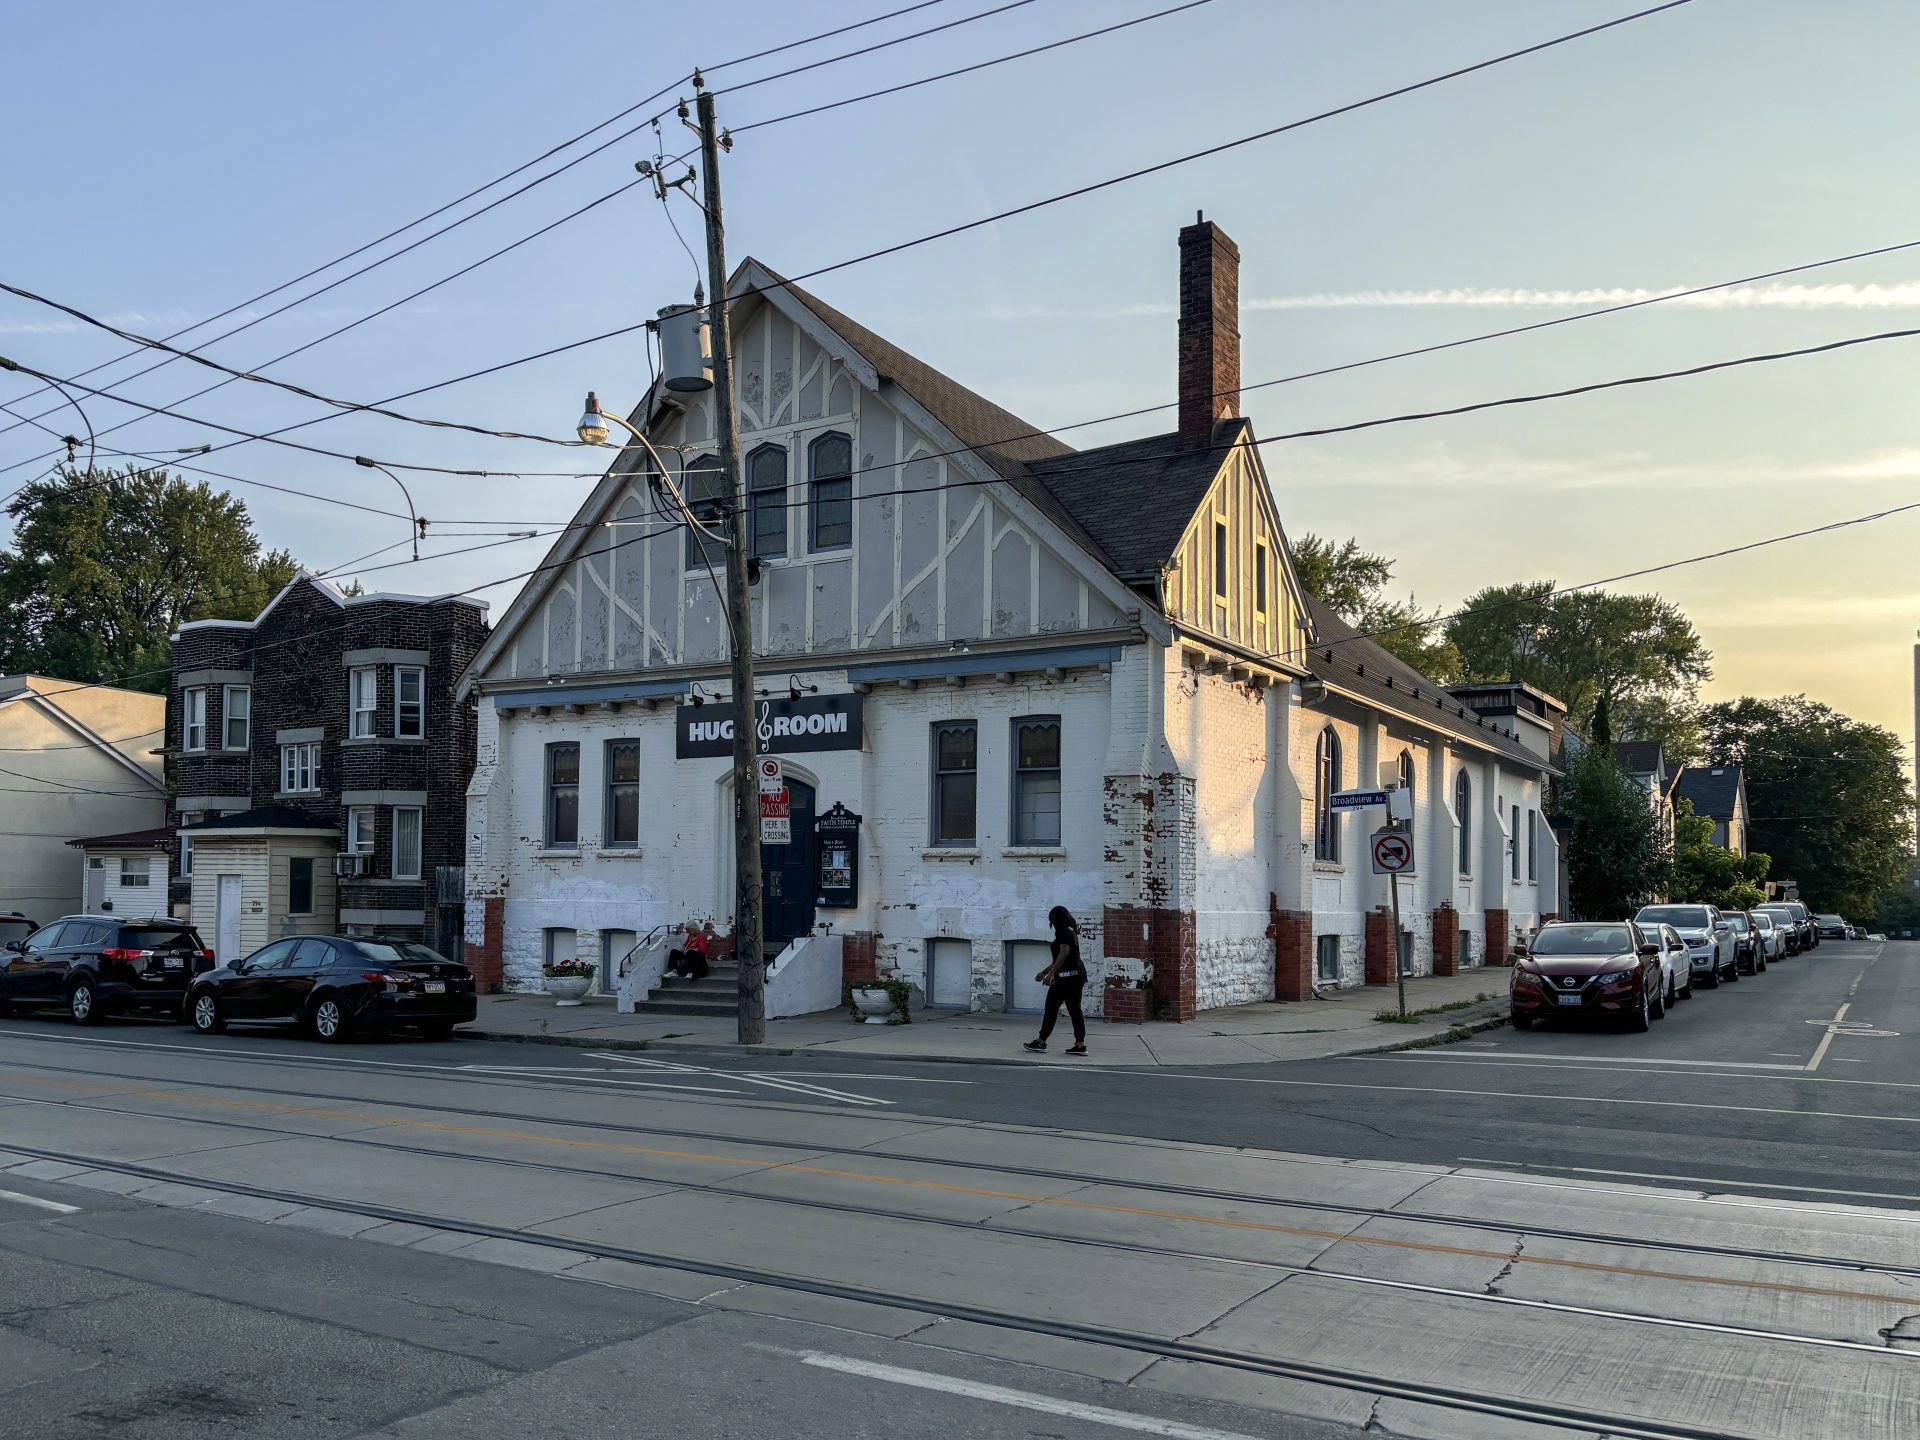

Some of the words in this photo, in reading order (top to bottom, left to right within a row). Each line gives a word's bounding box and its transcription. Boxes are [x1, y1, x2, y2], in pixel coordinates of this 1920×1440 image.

[773, 713, 848, 737] ROOM
[769, 793, 781, 802] NO
[1331, 795, 1372, 806] Broadview
[761, 803, 789, 816] PASSING
[764, 820, 778, 829] HERE
[780, 820, 787, 828] TO
[763, 831, 790, 840] CROSSING
